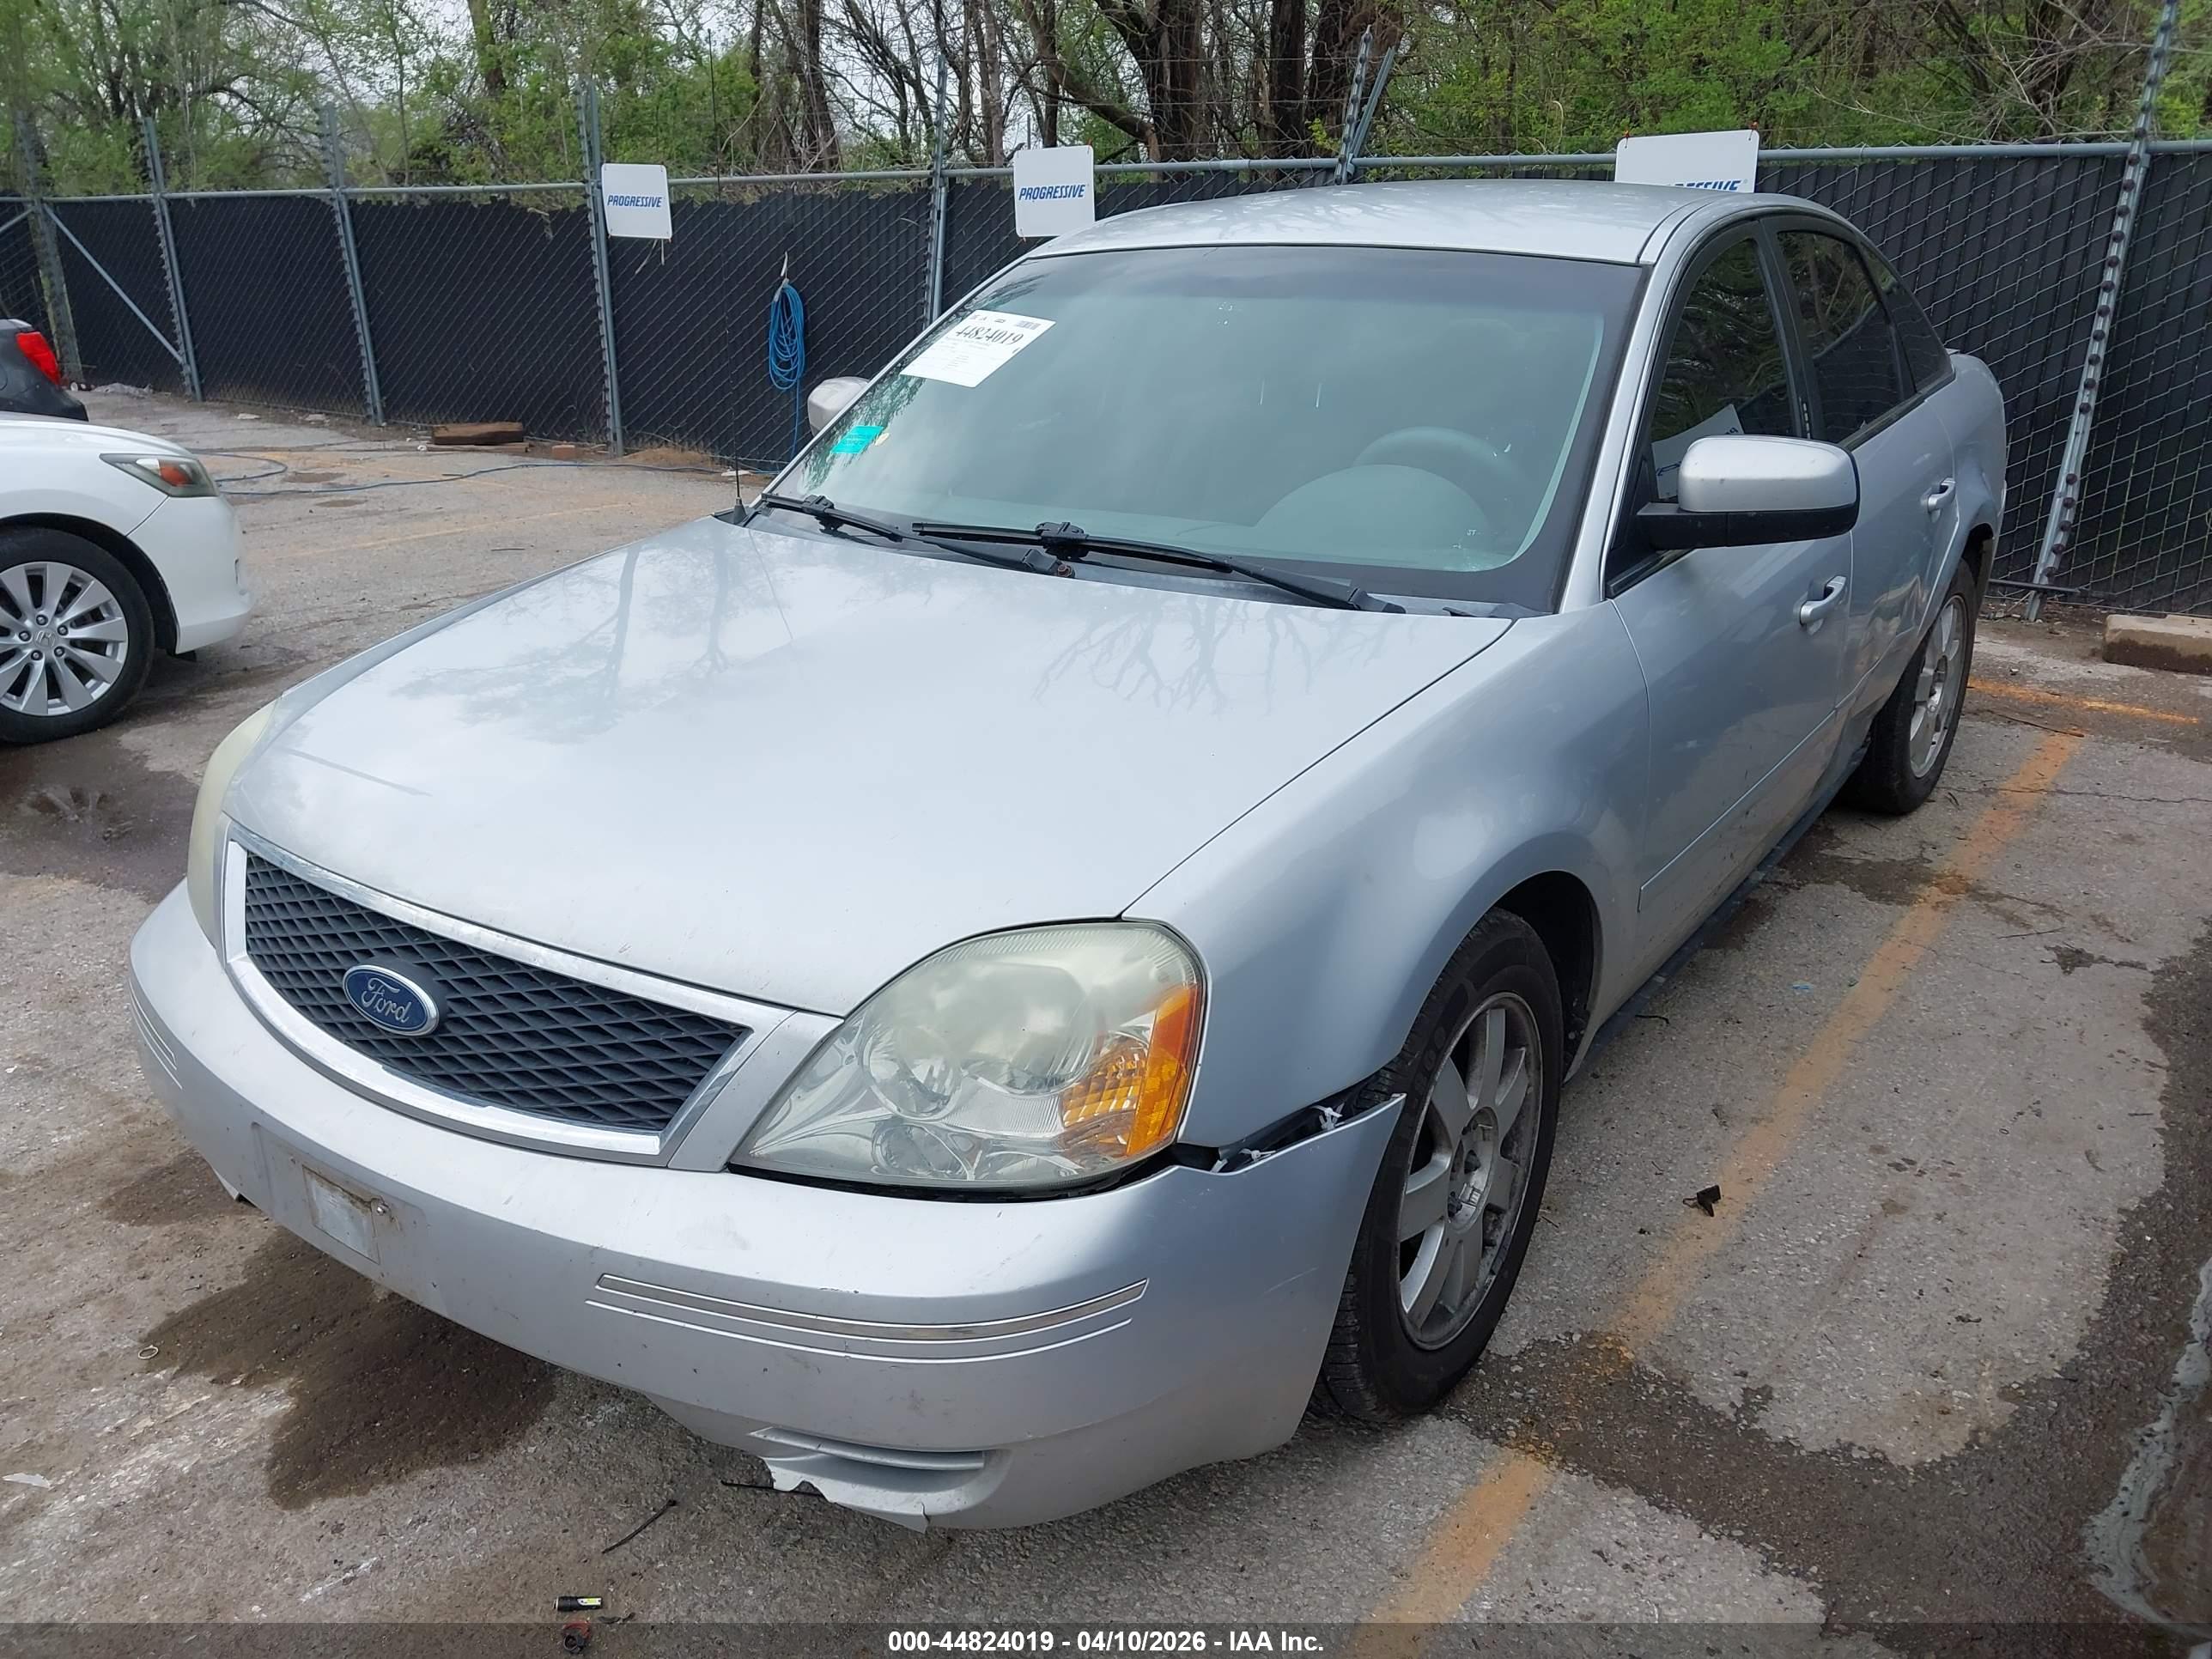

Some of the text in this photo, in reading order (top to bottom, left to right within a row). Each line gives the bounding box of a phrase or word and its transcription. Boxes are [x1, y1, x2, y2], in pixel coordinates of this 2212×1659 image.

[1018, 184, 1085, 200] PROGRESSIVE
[607, 195, 662, 208] PROGRESSIVE
[955, 325, 1024, 345] 44824019
[361, 977, 412, 1024] Ford
